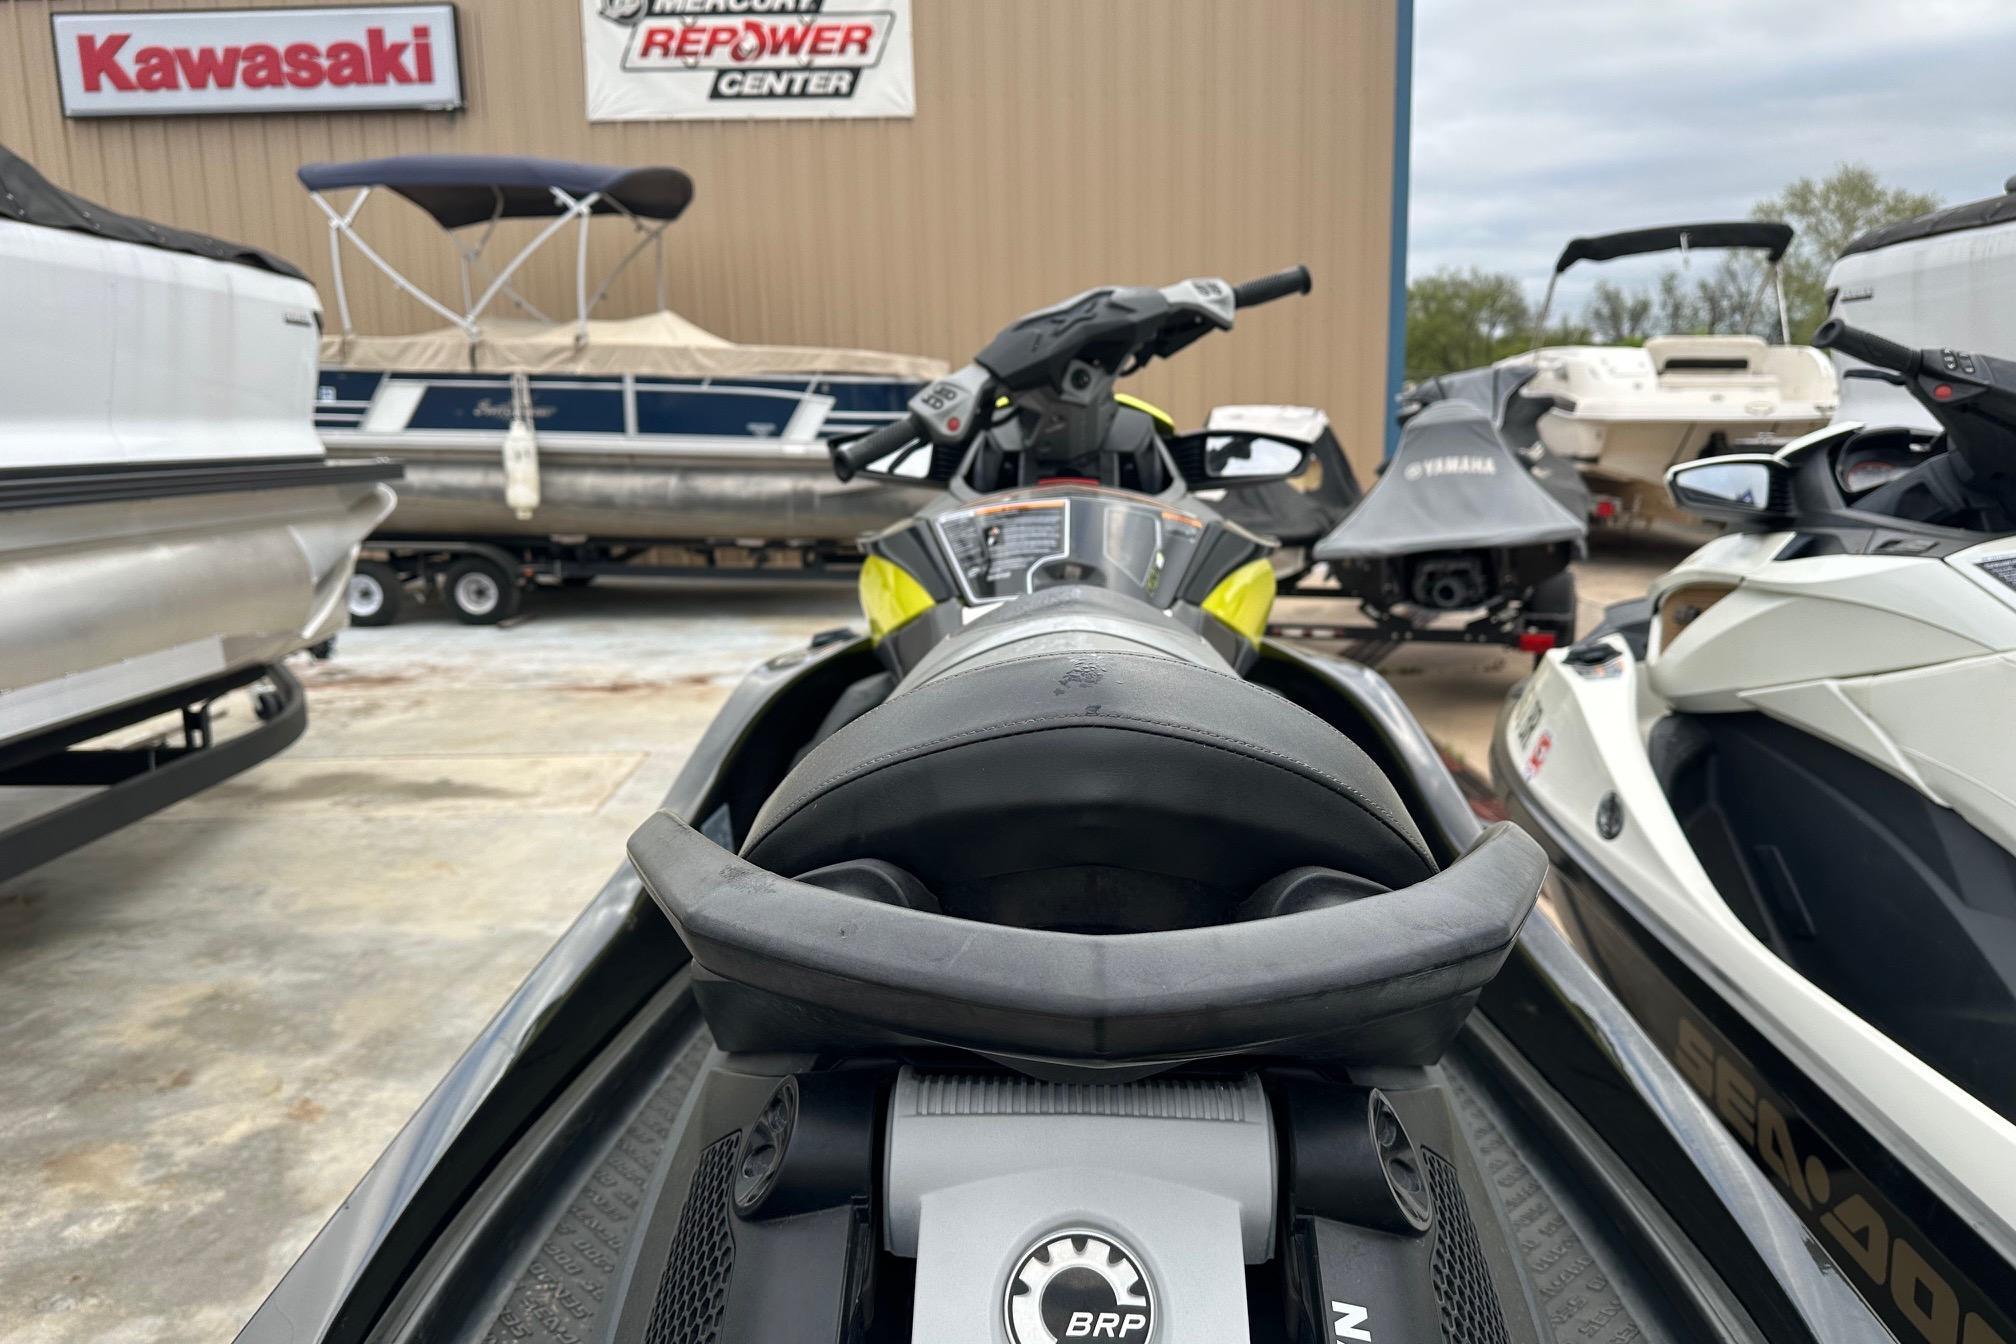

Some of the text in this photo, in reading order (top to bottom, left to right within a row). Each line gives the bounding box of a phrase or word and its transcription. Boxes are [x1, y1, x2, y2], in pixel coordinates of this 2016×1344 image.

[639, 20, 874, 62] REPOWER
[76, 26, 434, 93] Kawasaki
[717, 72, 853, 96] CENTER
[1423, 455, 1496, 476] YAMAHA
[1065, 1312, 1147, 1339] BRP
